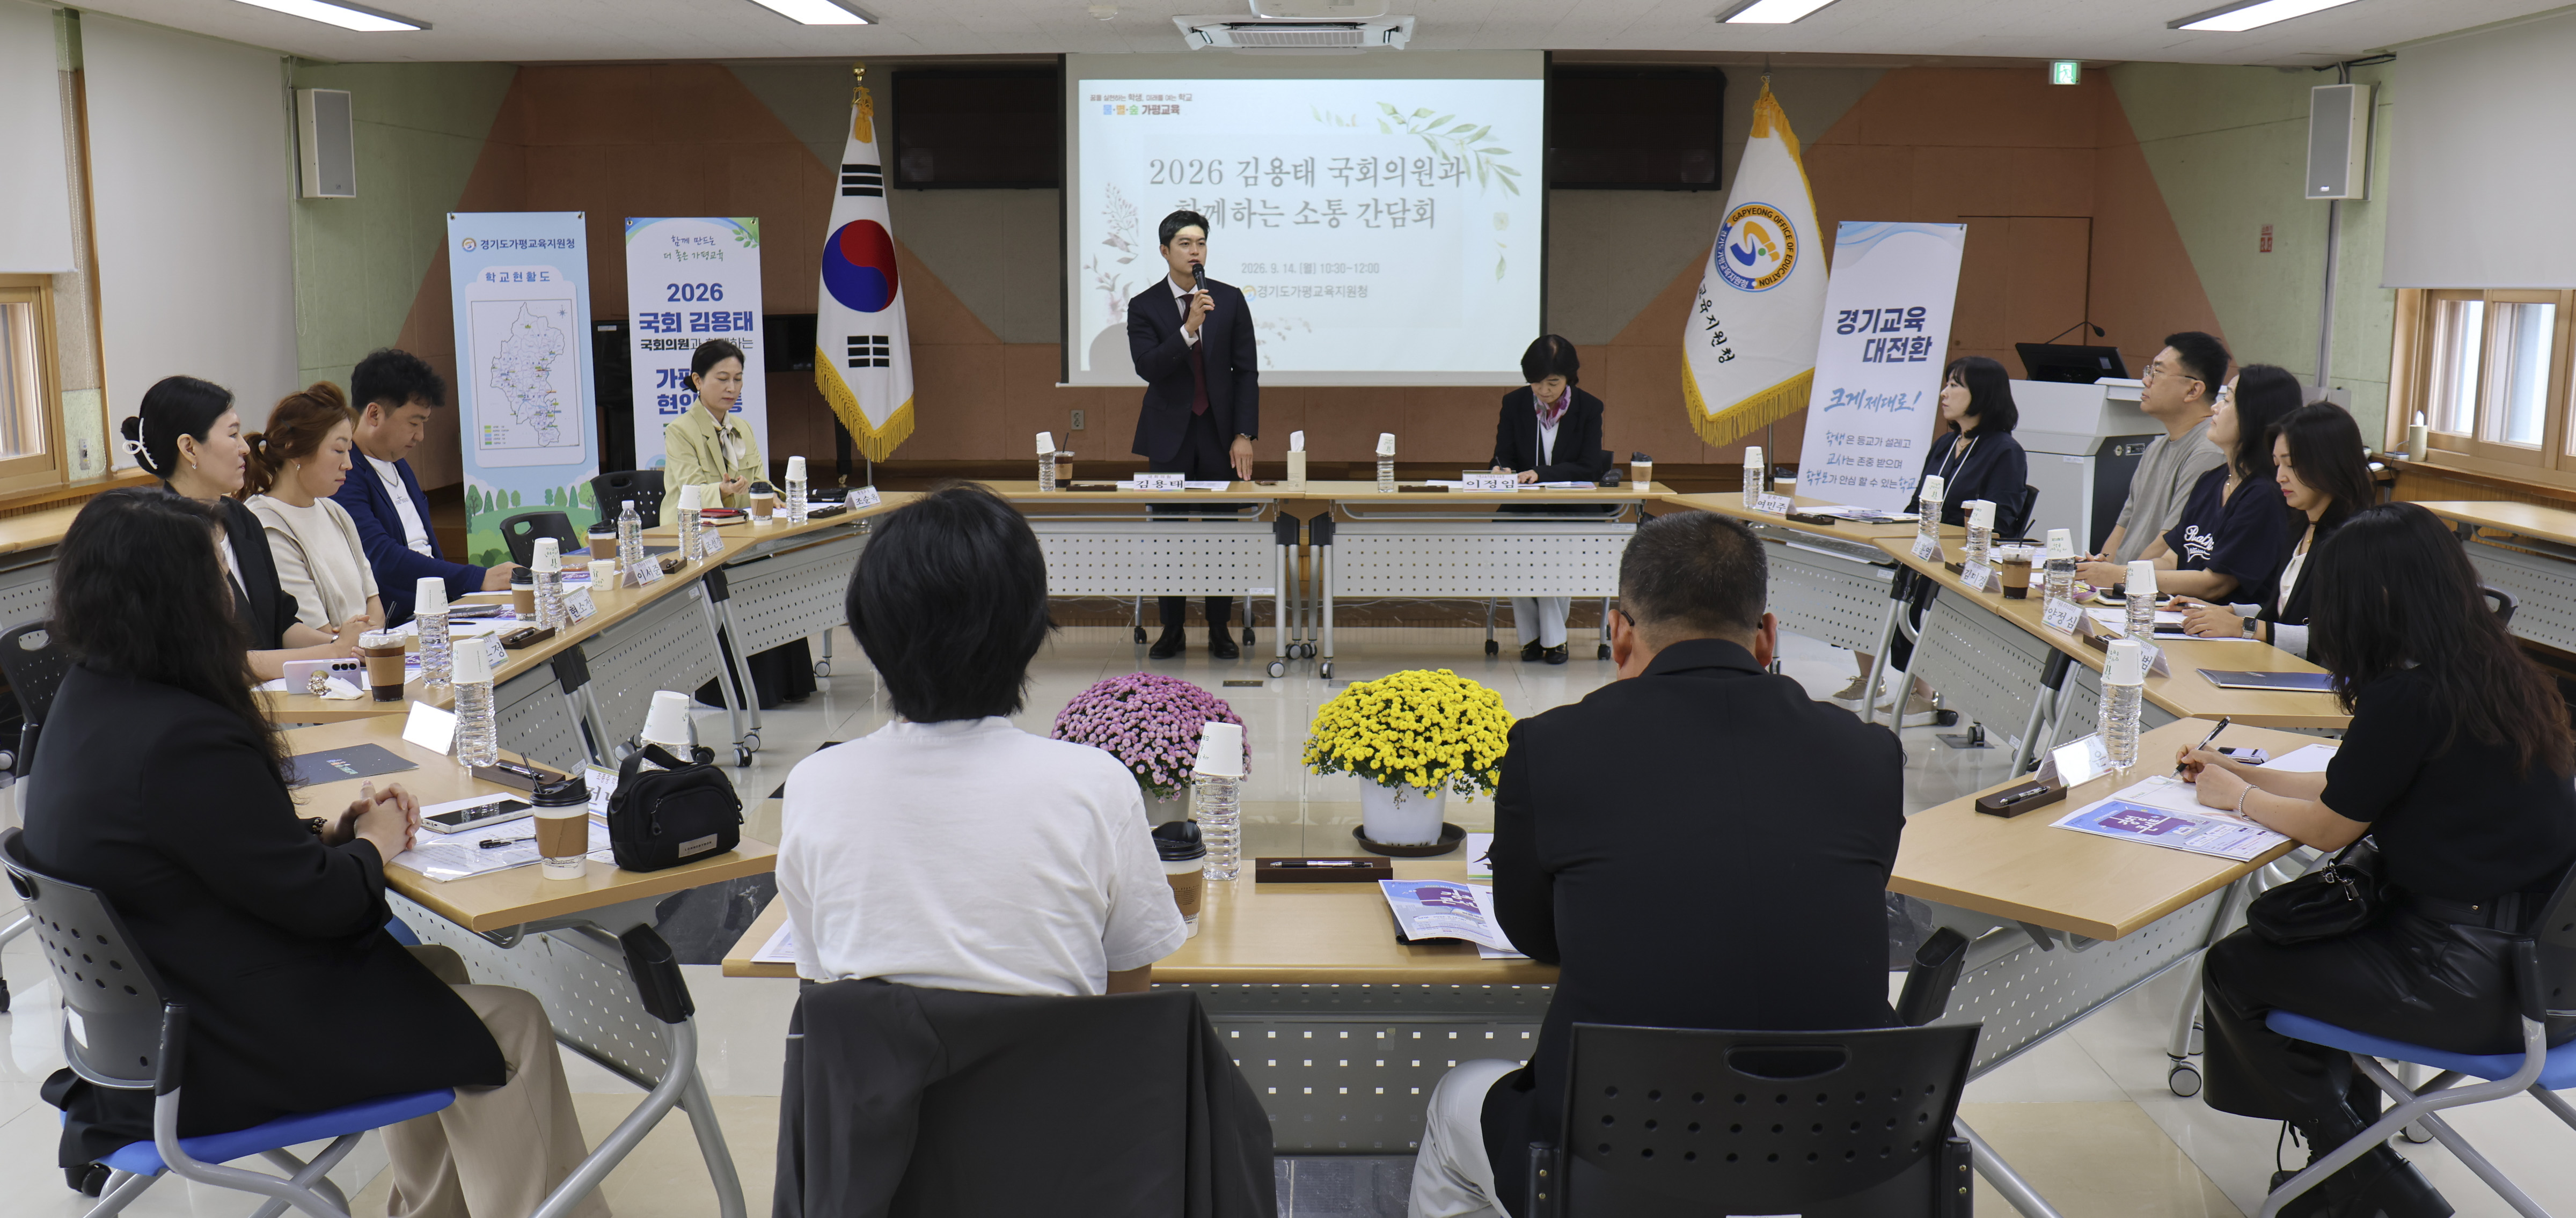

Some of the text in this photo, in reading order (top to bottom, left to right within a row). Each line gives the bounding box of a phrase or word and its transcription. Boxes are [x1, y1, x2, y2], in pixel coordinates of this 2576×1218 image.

[1178, 93, 1192, 101] 학교
[1142, 105, 1180, 115] 가평교육
[1150, 156, 1466, 188] 2026 김용태 국회의원과
[1292, 199, 1348, 229] 소통
[1356, 197, 1436, 230] 간담회
[480, 238, 575, 250] 경기도가평교육지원청
[671, 235, 716, 246] 함께 만드는
[1732, 208, 1794, 287] GAPYEONG OFFICE OF EDUCATION
[675, 249, 689, 262] 좋은
[691, 249, 724, 262] 가평교육
[1241, 263, 1267, 274] 2026.
[1270, 263, 1279, 274] 9.
[1283, 263, 1297, 274] 14.
[667, 283, 724, 302] 2026
[1257, 285, 1368, 298] 경기도가평교육지원청
[639, 311, 753, 334] 국회 김용태
[1837, 306, 1927, 335] 경기교육
[640, 338, 701, 351] 국회의원과
[1862, 336, 1933, 363] 대전환
[1824, 387, 1867, 413] 크게
[1857, 436, 1883, 446] 등교가
[1885, 438, 1911, 449] 설레고
[1827, 453, 1902, 469] 교사는 존중 받으며
[1136, 479, 1184, 489] 김용태
[1467, 479, 1514, 489] 이정임
[1806, 469, 1837, 486] 학부모가
[1840, 475, 1856, 486] 안심
[1859, 476, 1868, 487] 할
[1870, 479, 1878, 487] 수
[1880, 478, 1898, 489] 있는
[855, 493, 878, 505] 조순옥
[1758, 500, 1787, 512] 여민주
[637, 564, 661, 581] 이서준
[1964, 569, 1987, 587] 김미경
[569, 596, 594, 618] 현소정
[2047, 607, 2078, 629] 양정심
